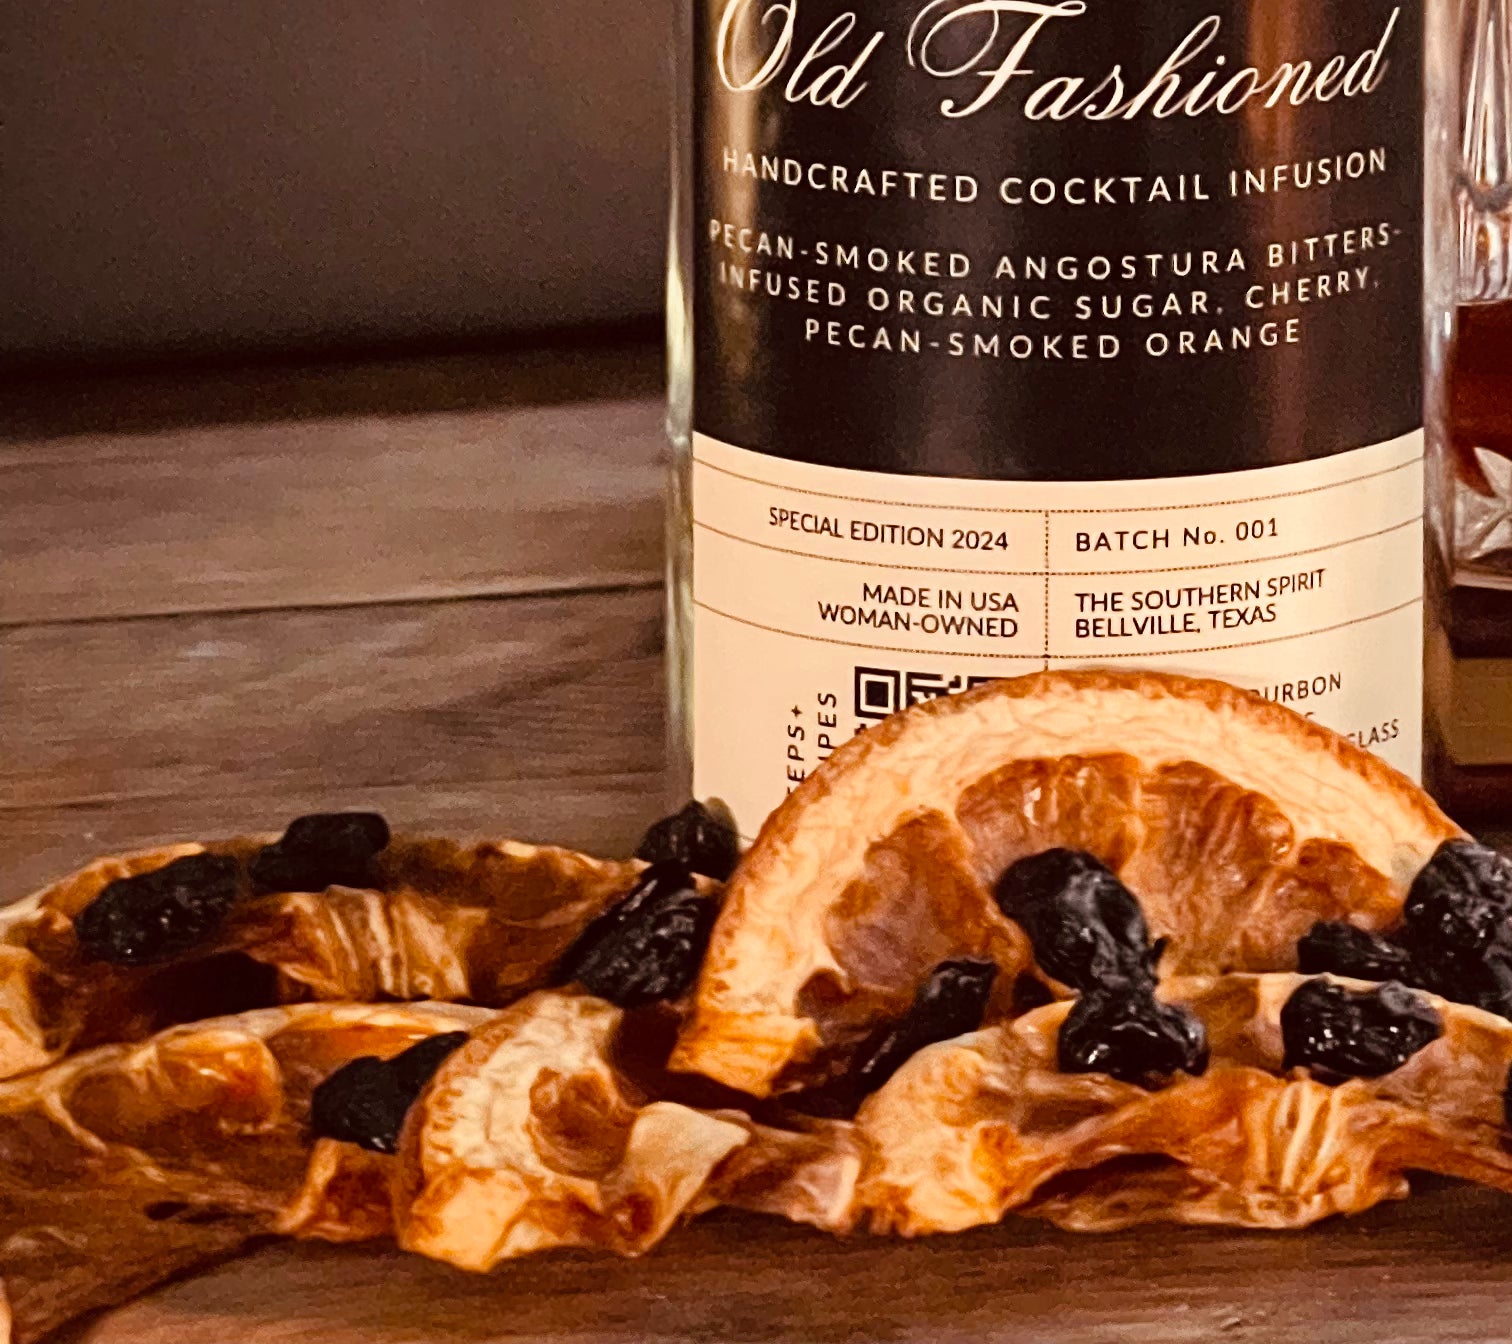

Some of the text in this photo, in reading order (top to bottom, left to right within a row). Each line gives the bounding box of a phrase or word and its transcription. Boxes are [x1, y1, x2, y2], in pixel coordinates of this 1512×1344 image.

[722, 146, 1386, 205] HANDCRAFTED COCKTAIL INFUSION
[708, 218, 1402, 281] PECAN-SMOKED ANGOSTURA BITTERS-
[720, 261, 847, 308] INFUSED
[867, 286, 1051, 321] ORGANIC
[805, 317, 1301, 360] PECAN-SMOKED ORANGE
[768, 507, 1010, 551] SPECIAL EDITION 2024
[1075, 516, 1279, 552] BATCH No. 001
[862, 582, 1020, 613] MADE IN USA
[1075, 567, 1327, 613] THE SOUTHERN SPIRIT
[818, 600, 1019, 639] WOMAN-OWNED
[1207, 603, 1277, 630] TEXAS
[787, 704, 806, 795] EPS+
